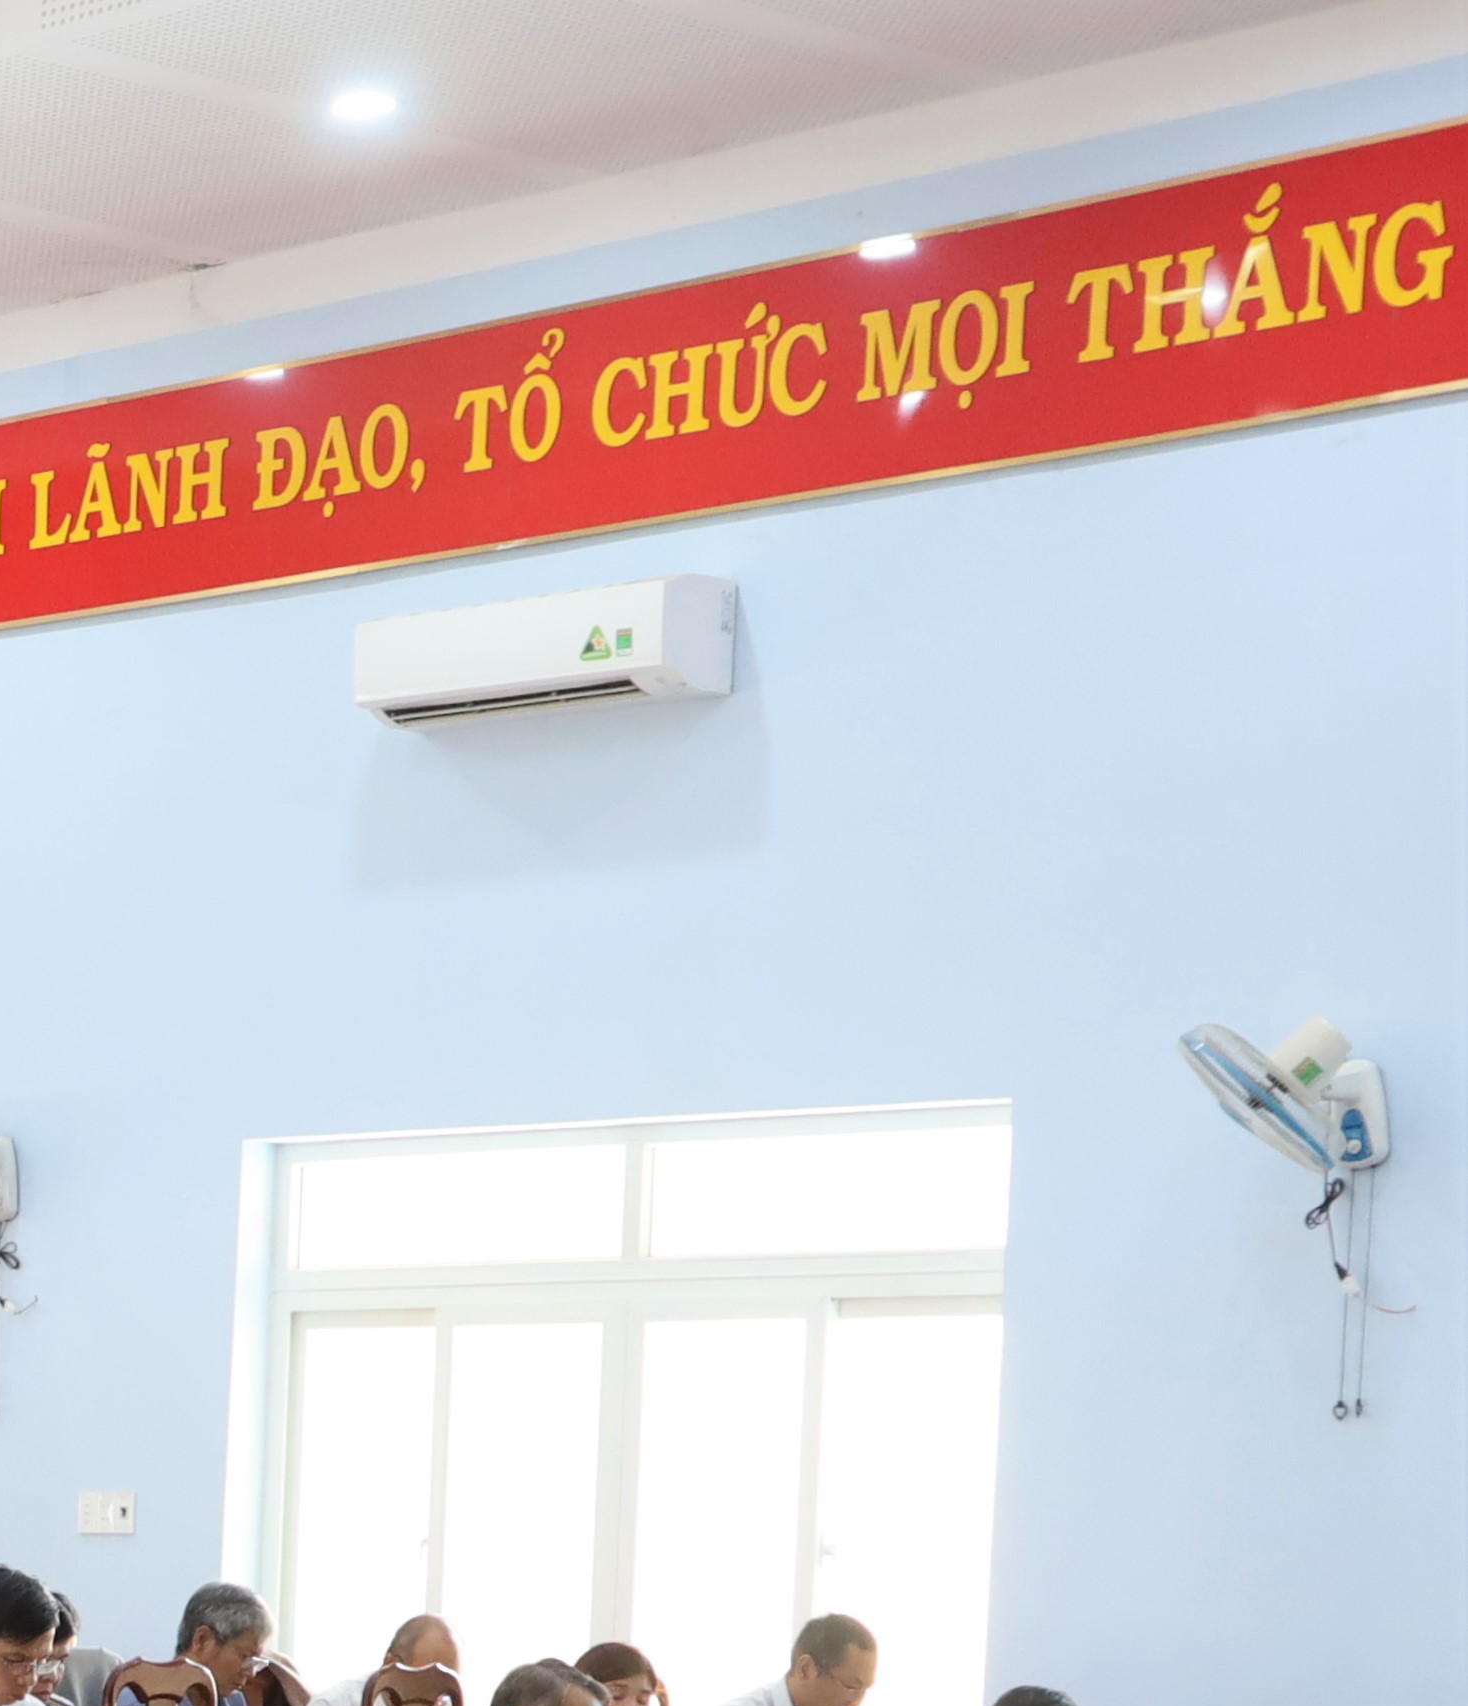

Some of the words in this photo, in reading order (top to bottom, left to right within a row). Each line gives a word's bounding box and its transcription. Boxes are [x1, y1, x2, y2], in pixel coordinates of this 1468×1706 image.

[29, 437, 230, 550] LÃNH
[252, 403, 426, 518] ĐẠO,
[453, 327, 565, 473] TỔ
[591, 301, 828, 448] CHỨC
[856, 280, 1035, 409] MỌI
[1066, 182, 1454, 363] THẮNG
